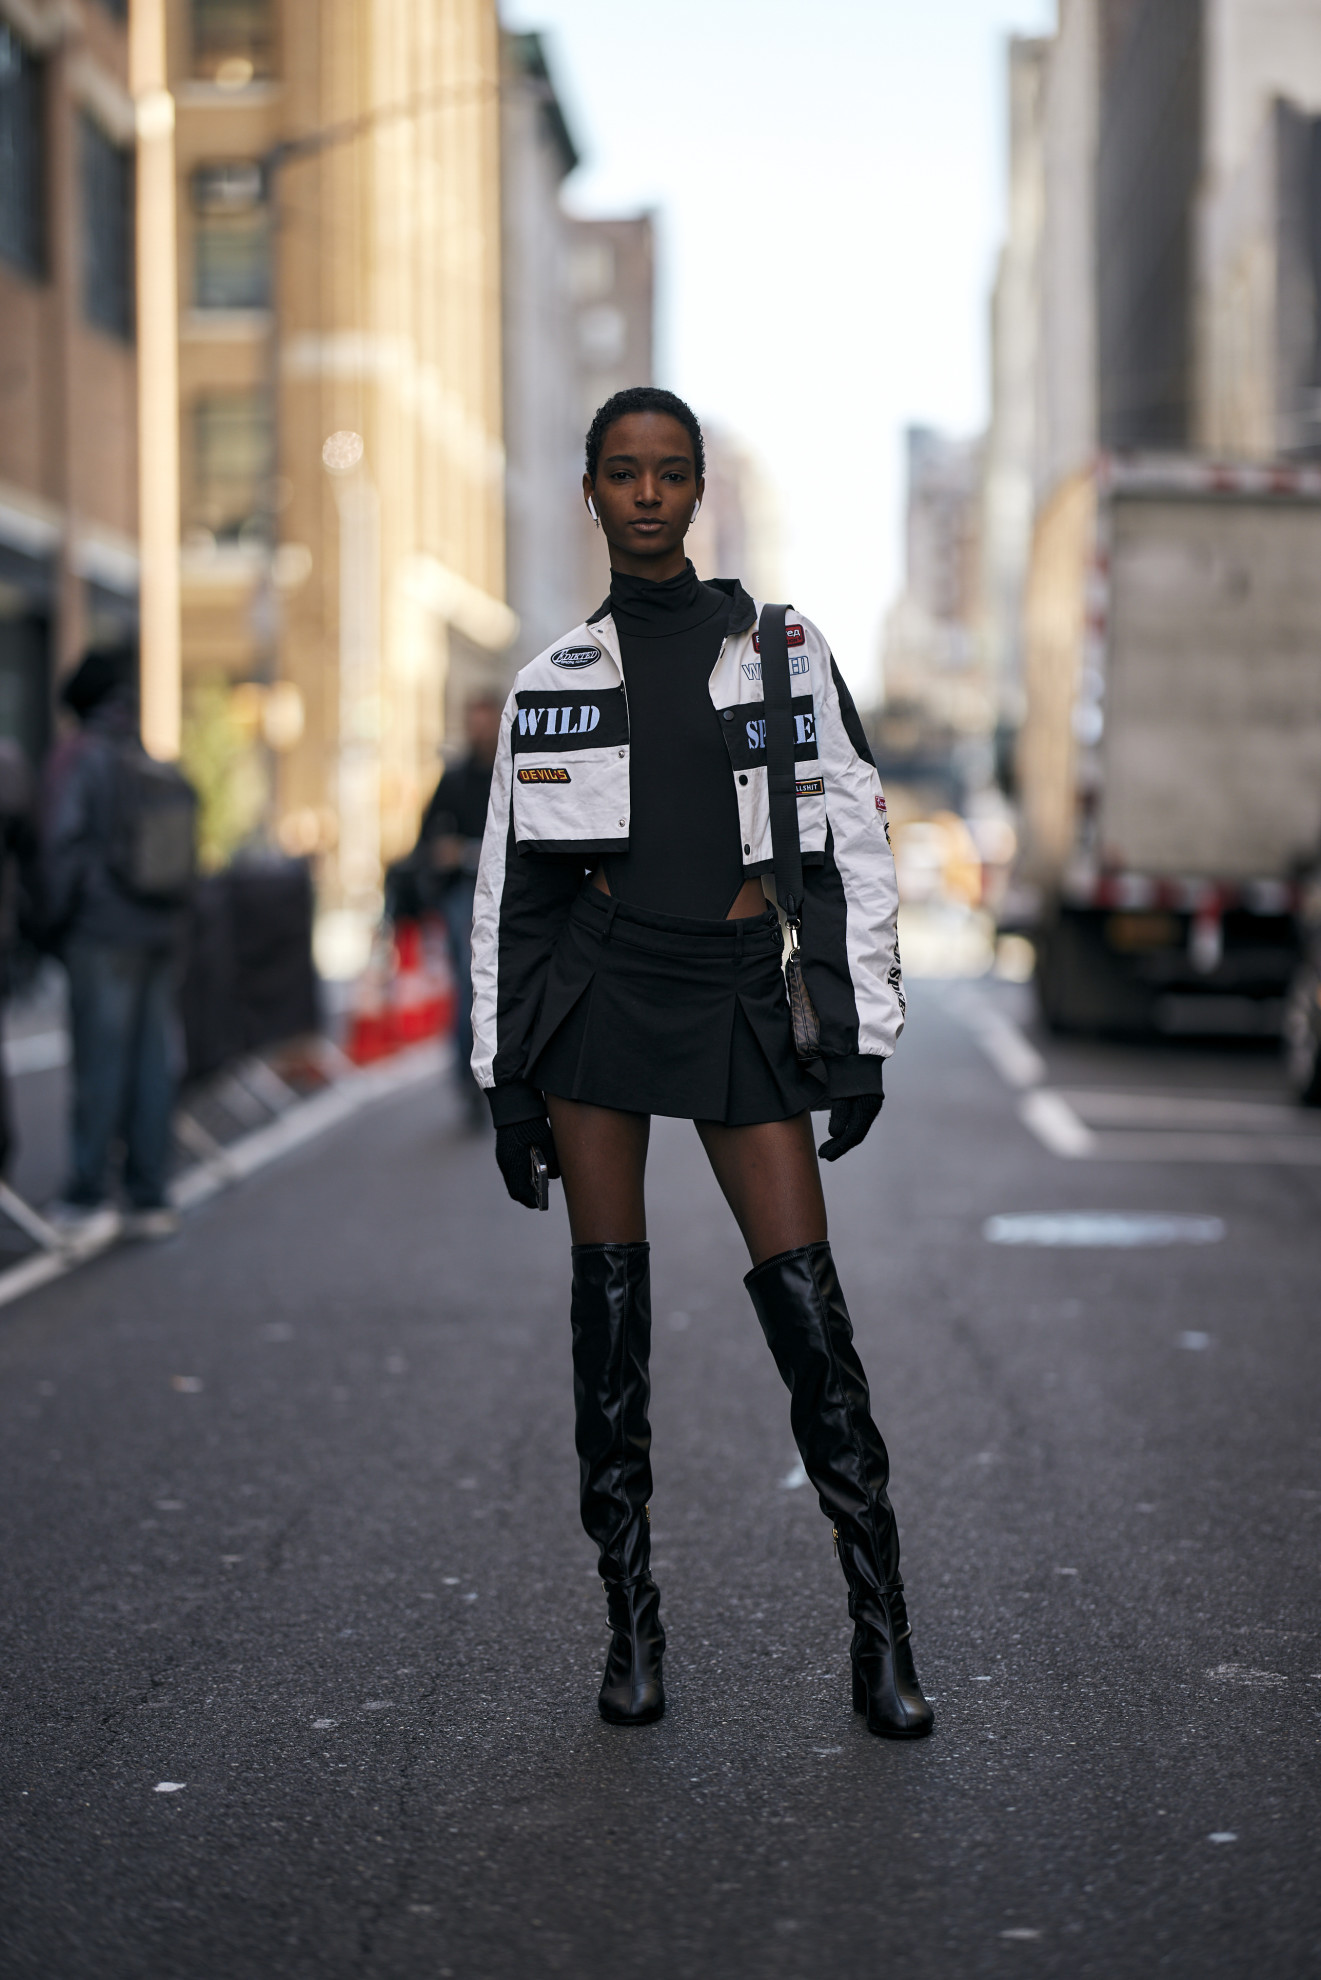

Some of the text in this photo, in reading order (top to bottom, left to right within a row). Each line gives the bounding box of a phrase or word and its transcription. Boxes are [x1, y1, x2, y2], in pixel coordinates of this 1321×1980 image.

[518, 705, 601, 736] WILD
[745, 713, 817, 750] SPE
[795, 783, 818, 793] LLSHIT
